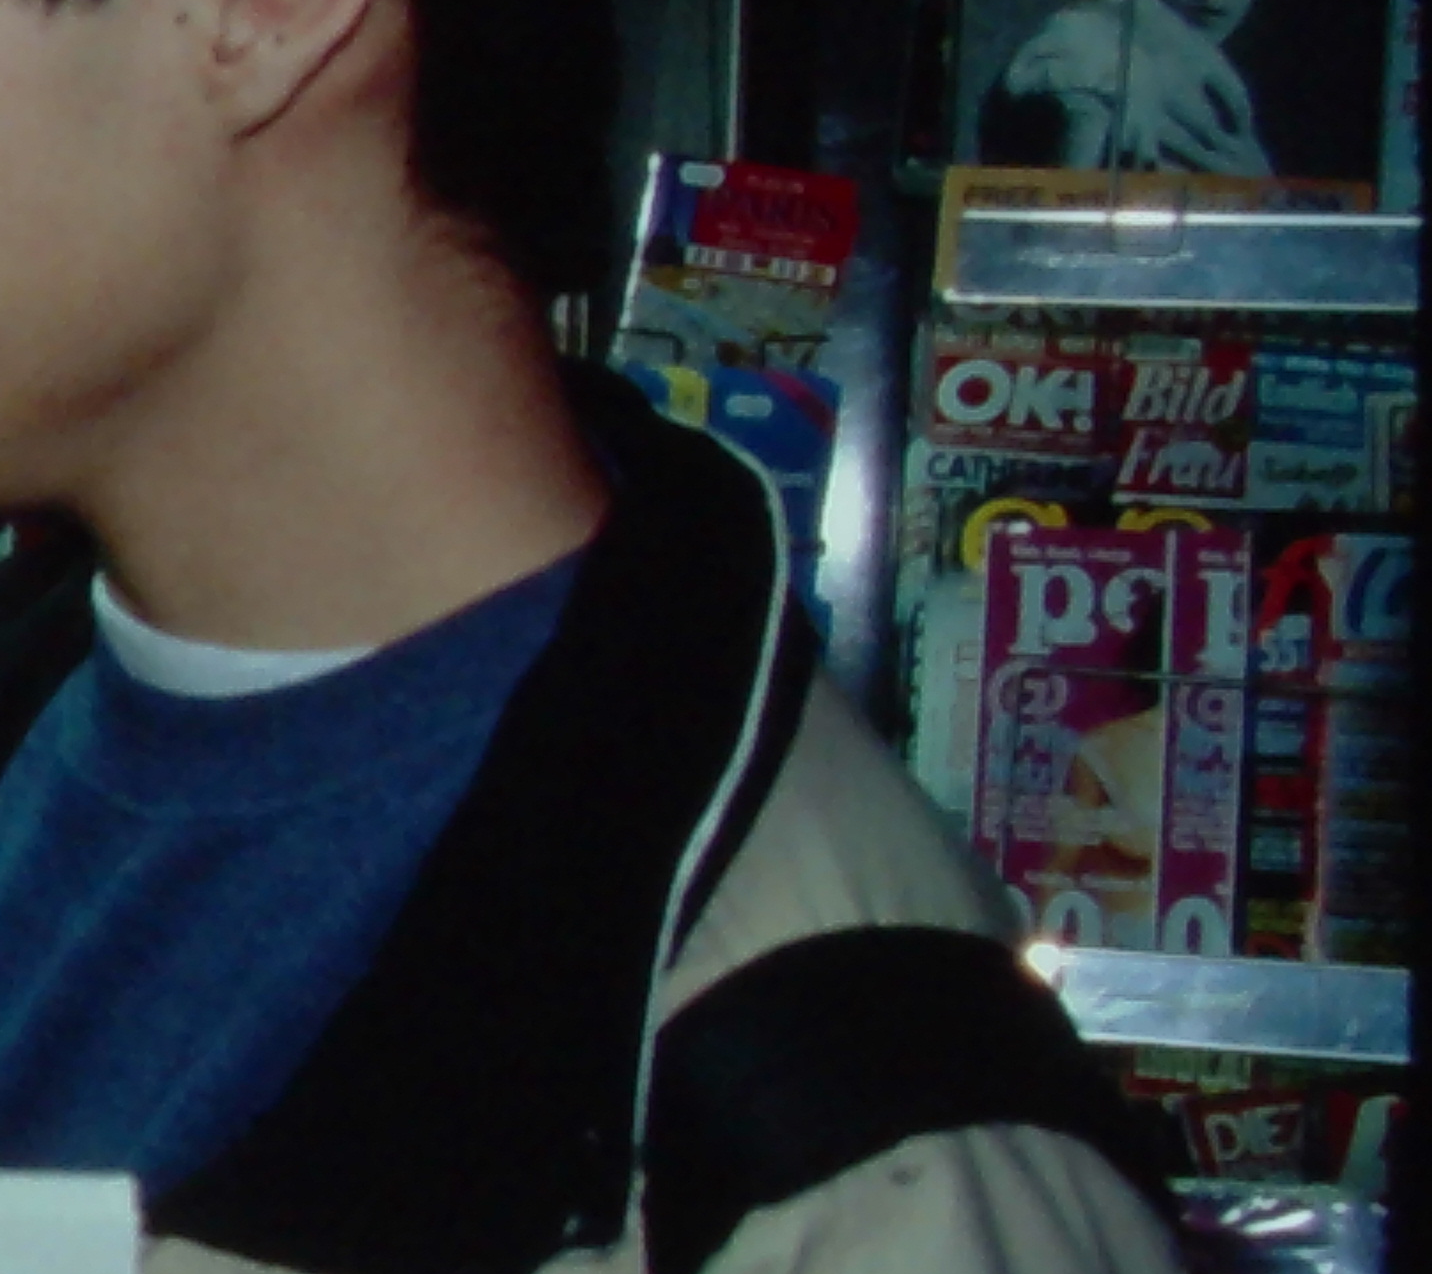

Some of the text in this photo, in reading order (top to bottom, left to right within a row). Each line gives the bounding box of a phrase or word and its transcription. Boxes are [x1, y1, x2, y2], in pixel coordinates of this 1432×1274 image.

[937, 358, 1097, 435] OK!
[1122, 358, 1248, 425] Bild
[1114, 434, 1245, 494] Frau
